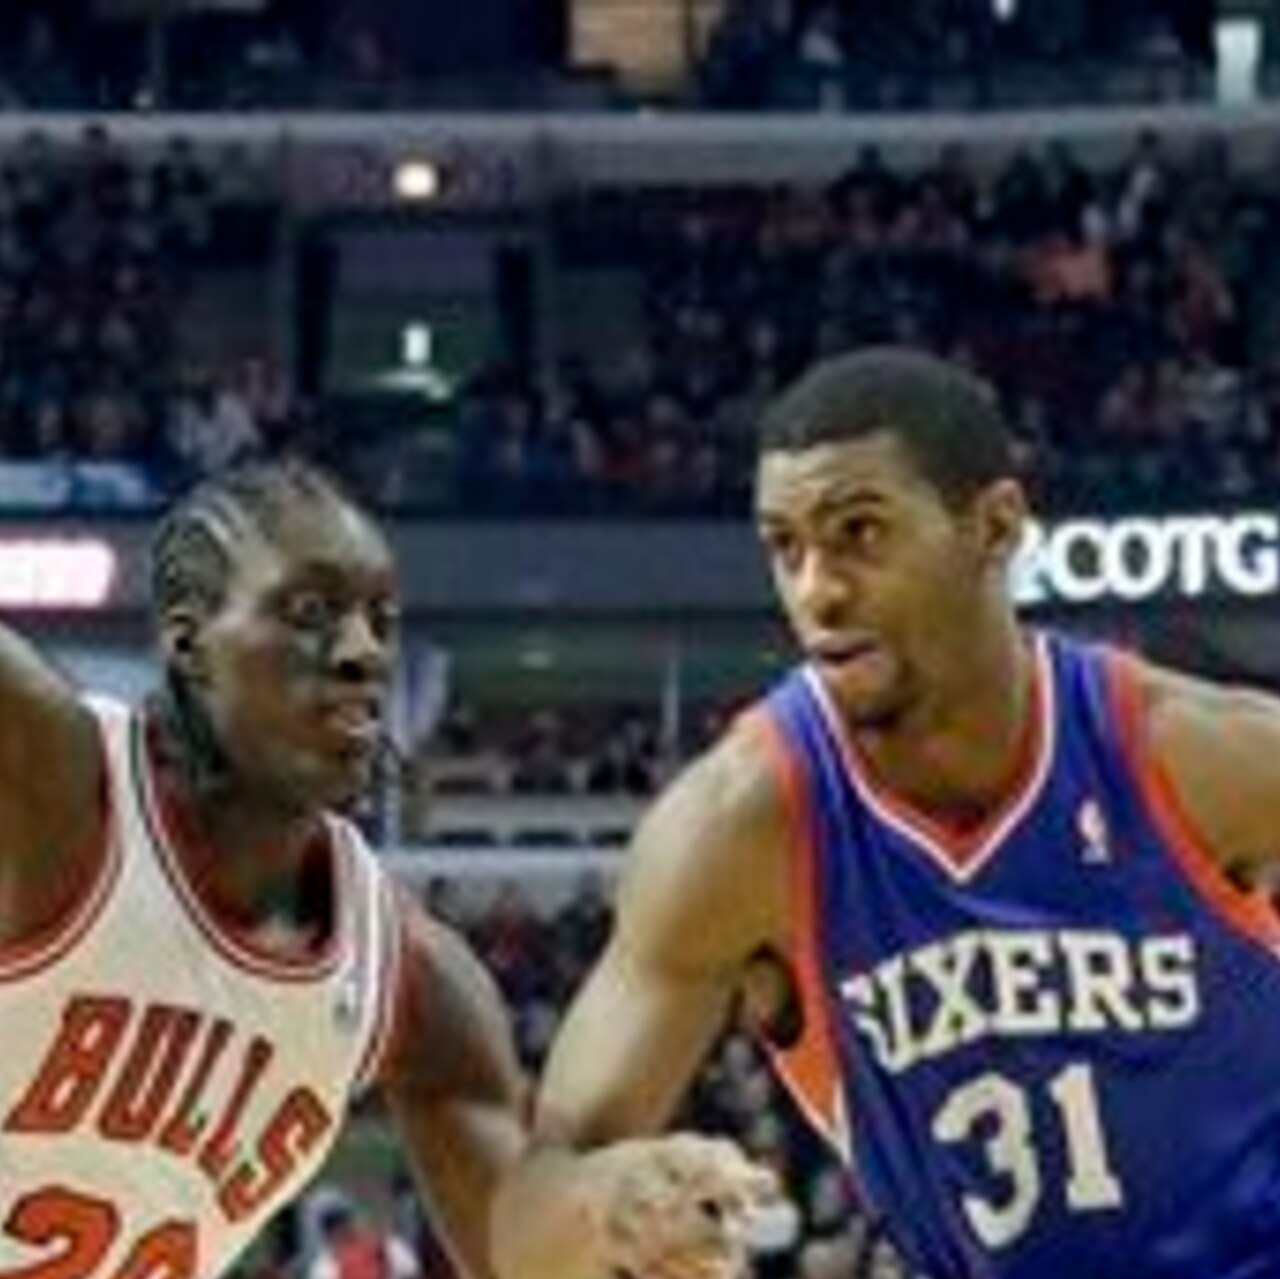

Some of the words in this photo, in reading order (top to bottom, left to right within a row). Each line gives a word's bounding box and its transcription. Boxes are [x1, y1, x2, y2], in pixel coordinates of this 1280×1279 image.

[840, 928, 1202, 1073] SIXERS
[2, 996, 332, 1222] BULLS
[932, 1064, 1122, 1250] 31
